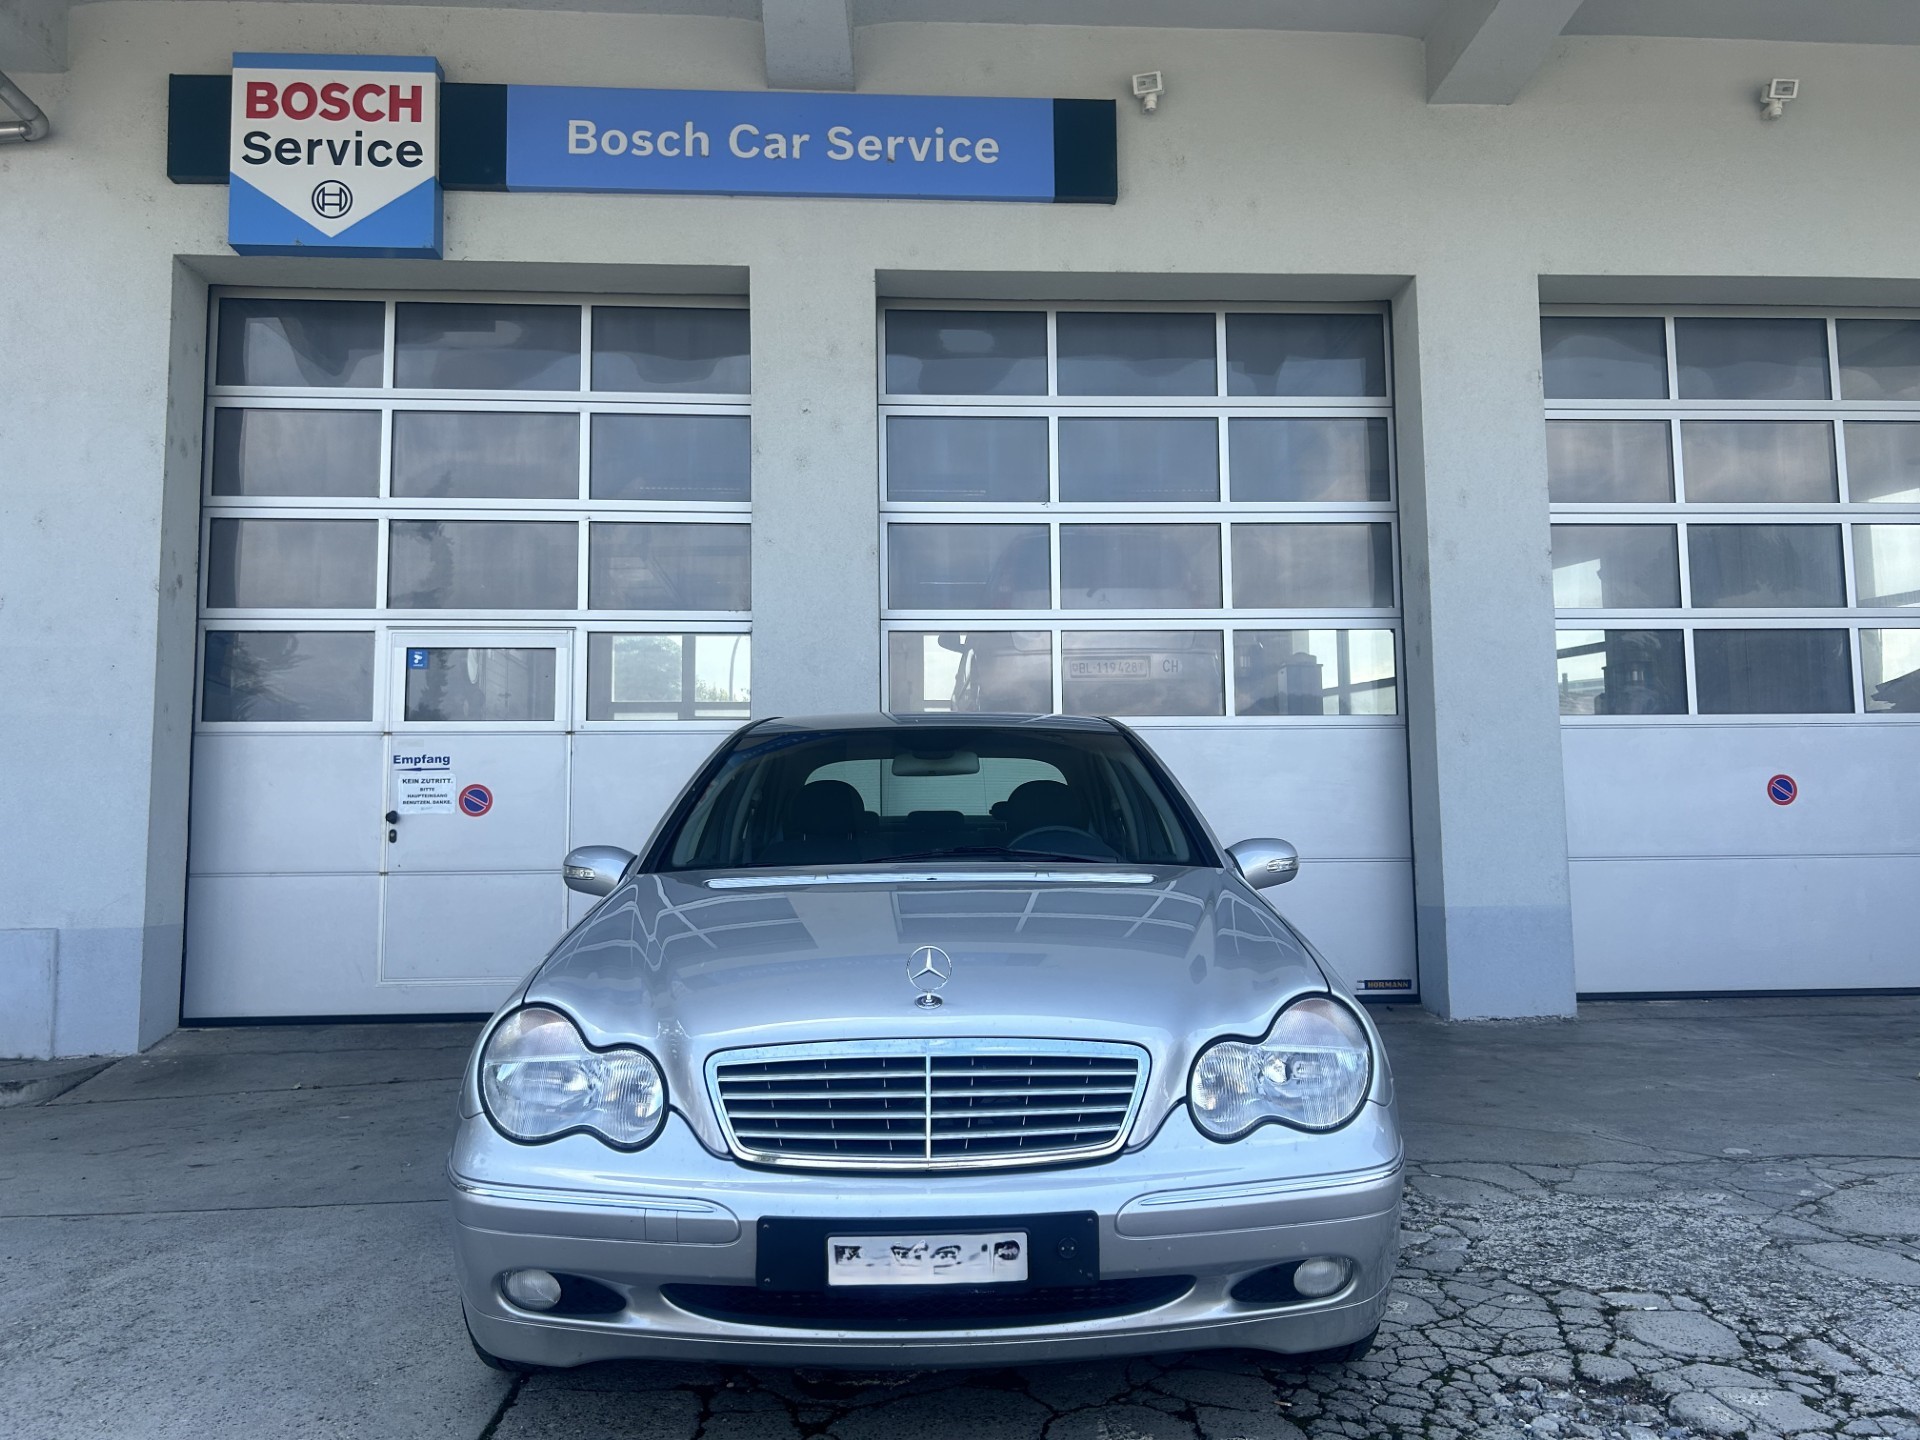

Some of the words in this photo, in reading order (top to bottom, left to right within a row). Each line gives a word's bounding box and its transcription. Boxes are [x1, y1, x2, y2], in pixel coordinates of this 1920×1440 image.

[245, 81, 423, 123] BOSCH
[241, 130, 424, 168] Service
[567, 120, 710, 158] Bosch
[728, 124, 811, 160] Car
[826, 127, 1000, 165] Service
[1162, 659, 1179, 673] CH
[393, 754, 451, 766] Empfang
